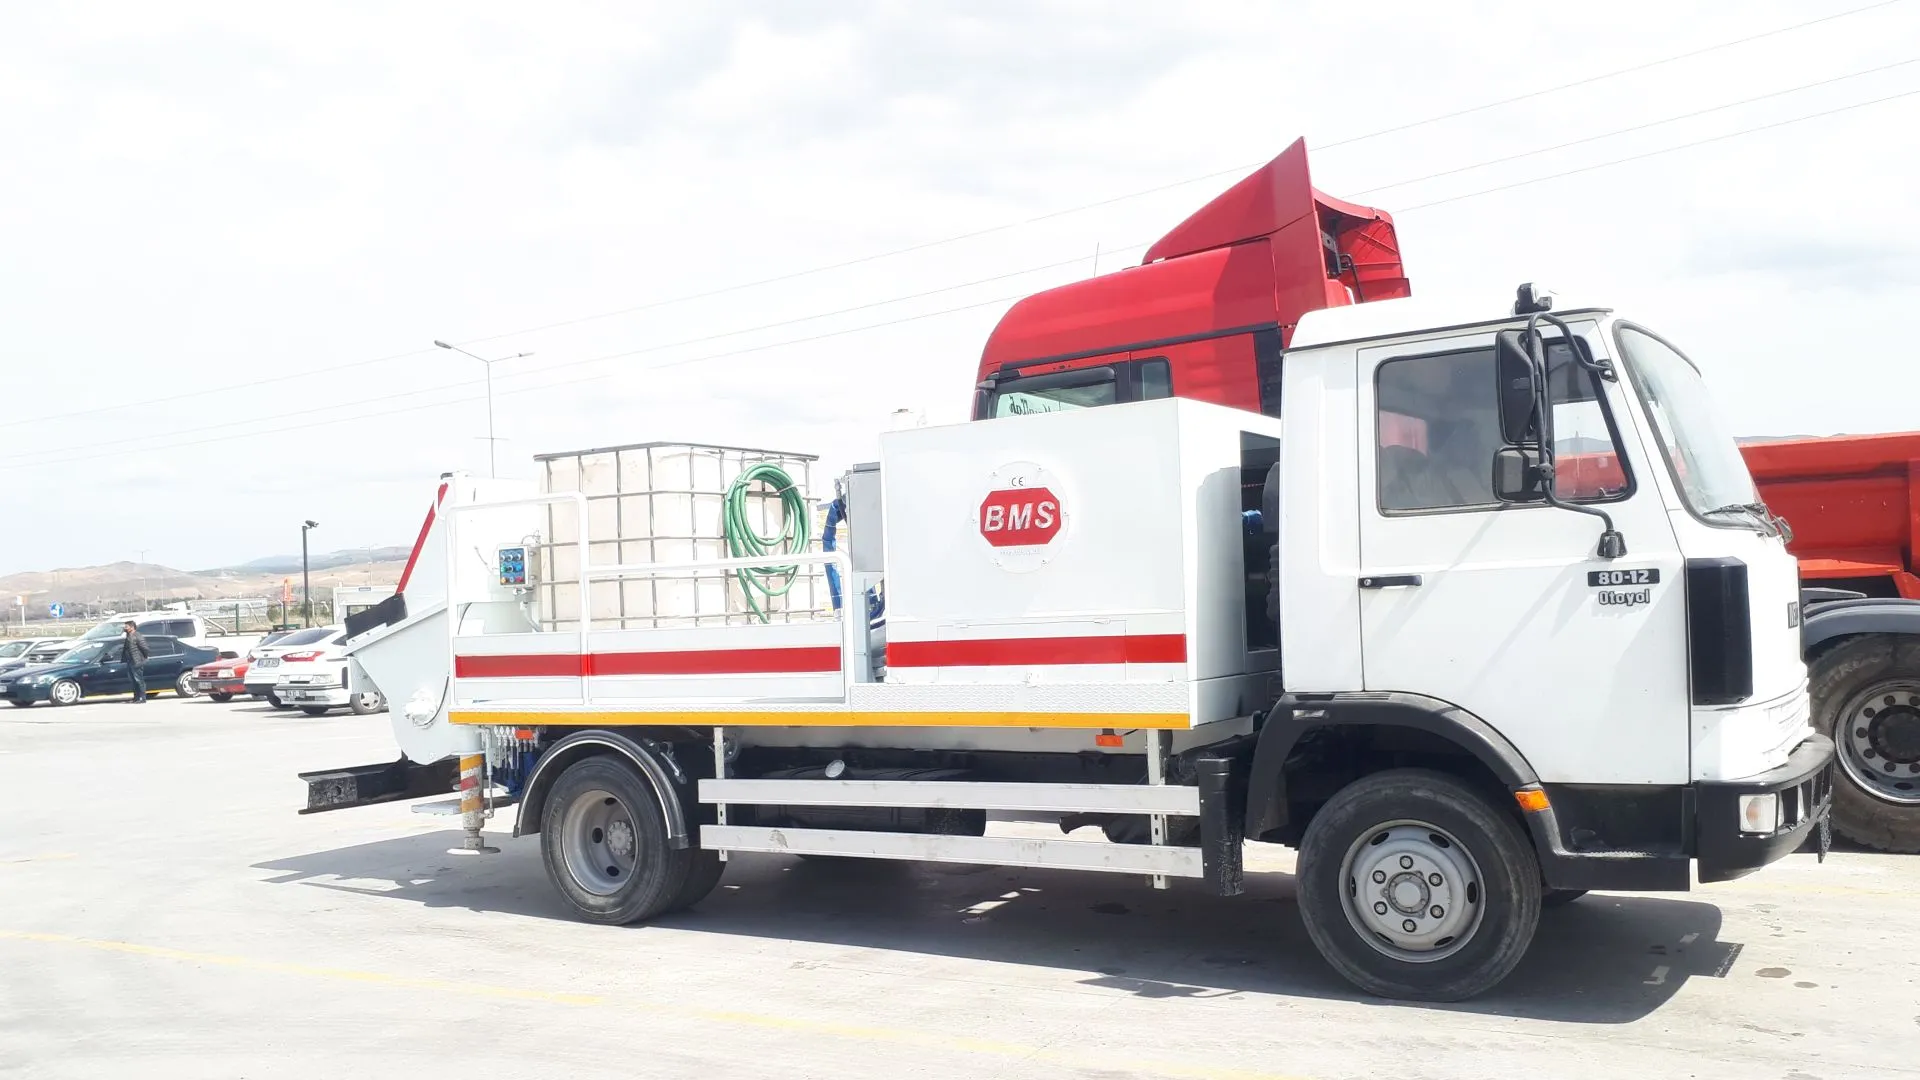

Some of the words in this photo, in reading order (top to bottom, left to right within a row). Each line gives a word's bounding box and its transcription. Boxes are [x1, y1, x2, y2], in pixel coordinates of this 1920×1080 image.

[1011, 476, 1024, 487] CE
[984, 500, 1056, 532] BMS
[1598, 569, 1650, 585] 80-12
[1598, 588, 1651, 606] Otoyol
